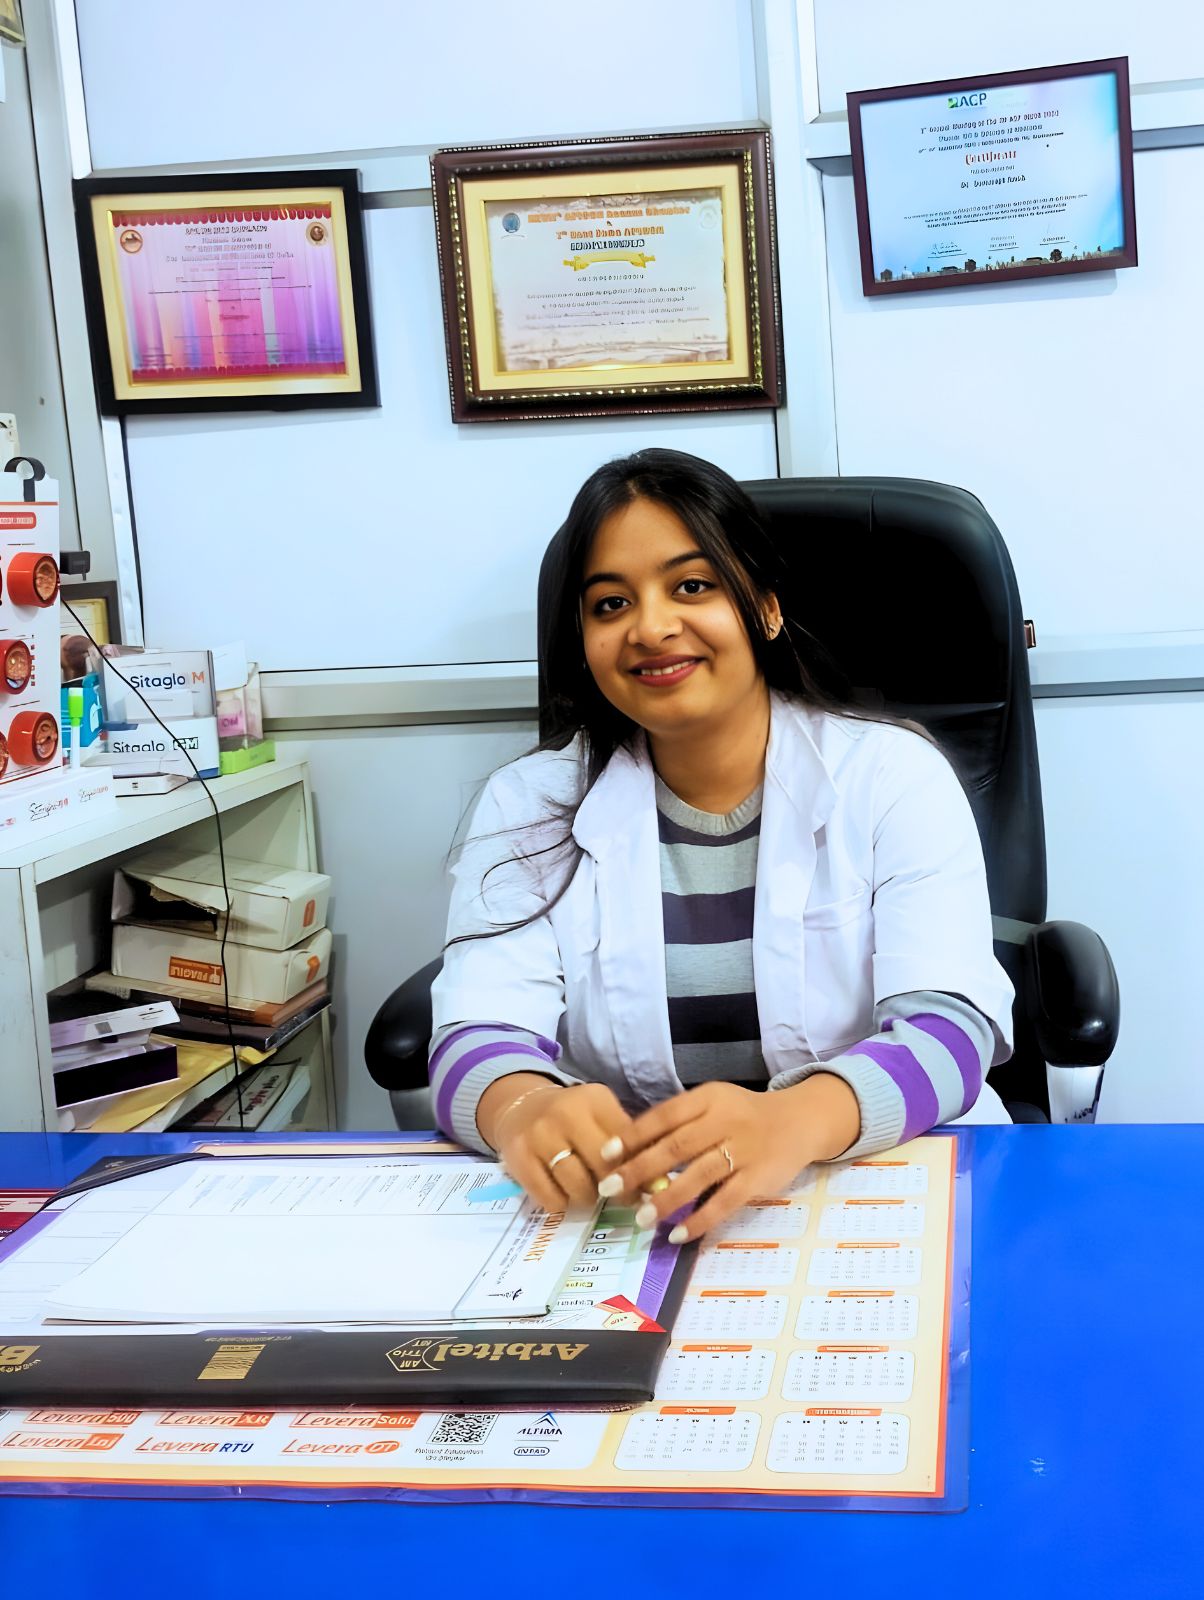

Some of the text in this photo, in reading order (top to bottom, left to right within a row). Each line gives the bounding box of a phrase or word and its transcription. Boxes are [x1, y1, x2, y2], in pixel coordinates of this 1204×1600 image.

[130, 671, 205, 690] Sitaglo M
[433, 1343, 590, 1361] Arbitel
[295, 1412, 377, 1426] Levera
[136, 1436, 255, 1453] Levera RTU
[282, 1438, 364, 1454] Levera
